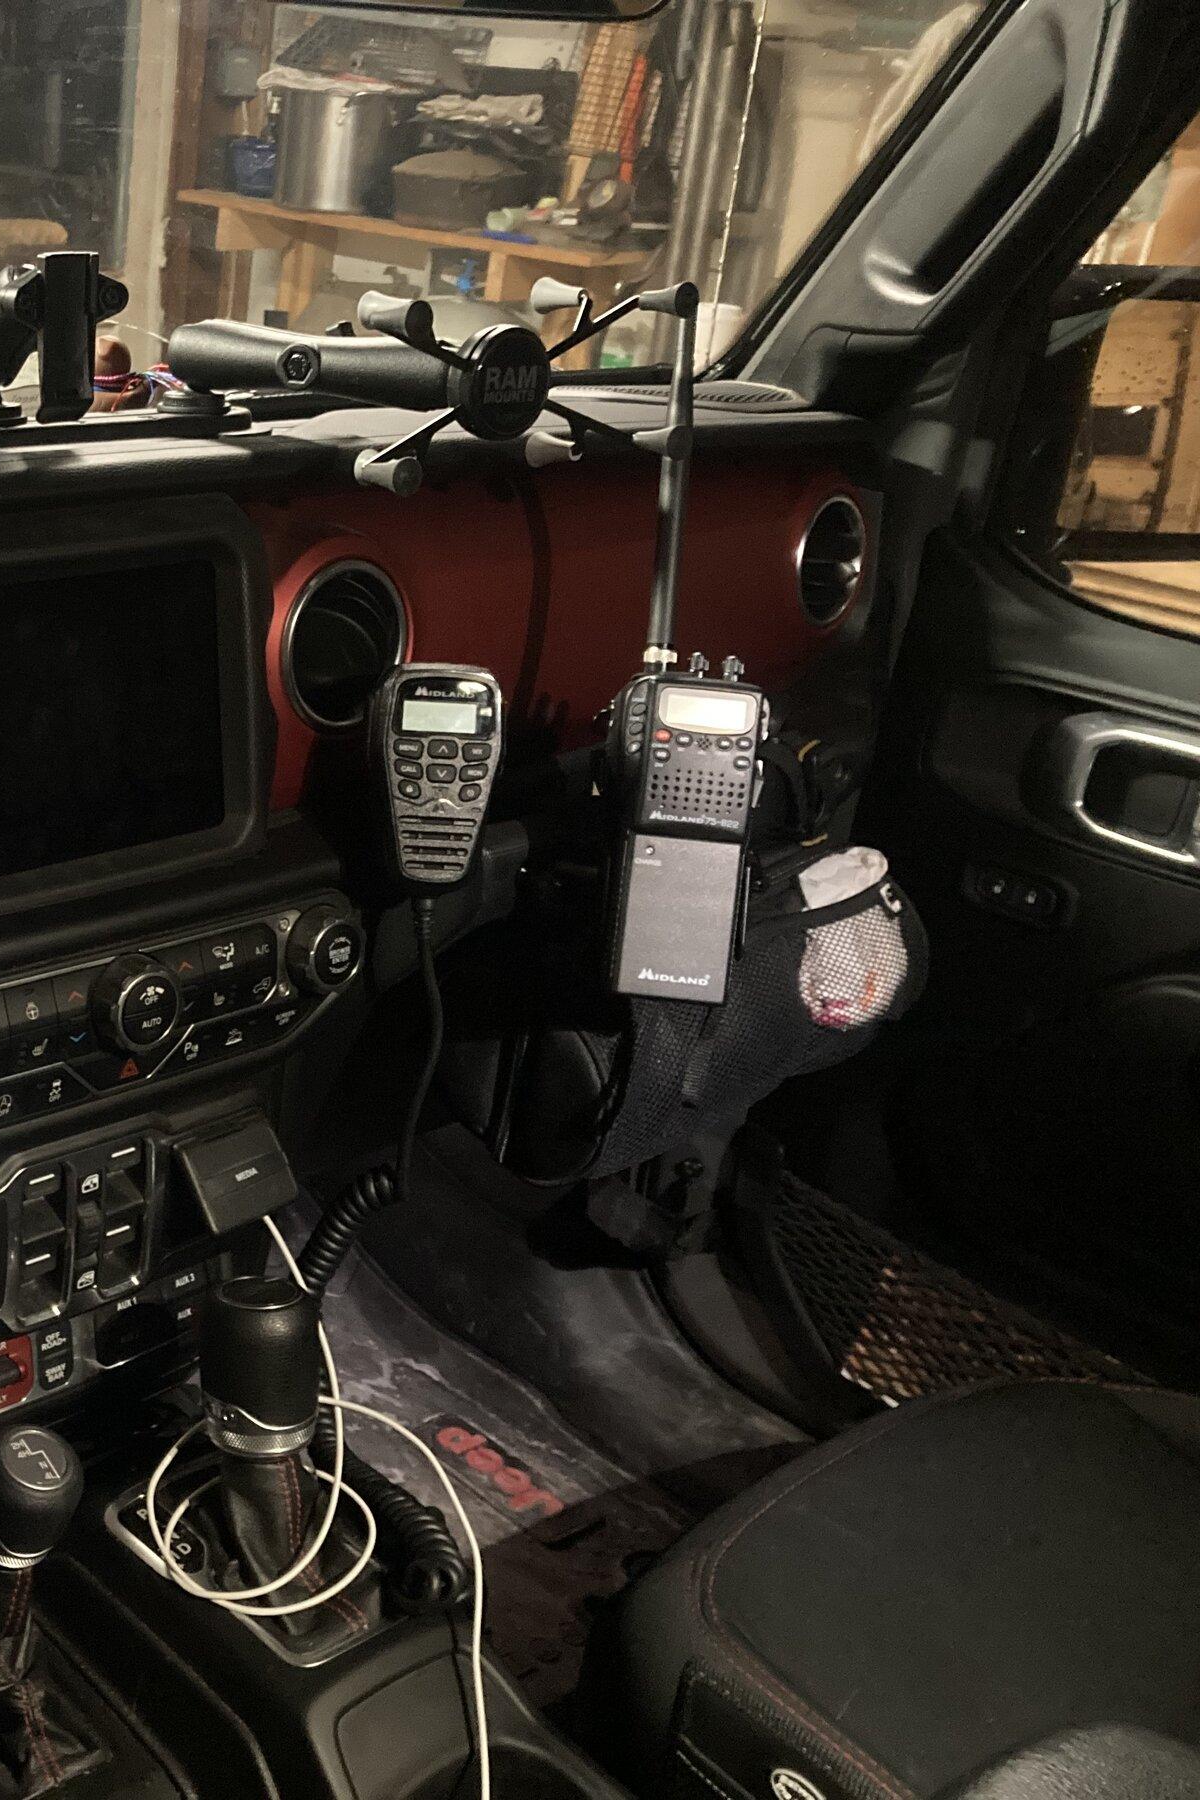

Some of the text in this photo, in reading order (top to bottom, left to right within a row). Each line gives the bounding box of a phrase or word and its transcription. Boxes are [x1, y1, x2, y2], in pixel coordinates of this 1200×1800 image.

[484, 365, 538, 391] RAM
[414, 686, 475, 699] MIDLAND
[649, 809, 704, 824] MIDLAND
[638, 967, 710, 986] MIDLAND
[144, 995, 159, 1006] OFF
[142, 1016, 162, 1030] AUTO
[176, 1542, 192, 1555] D
